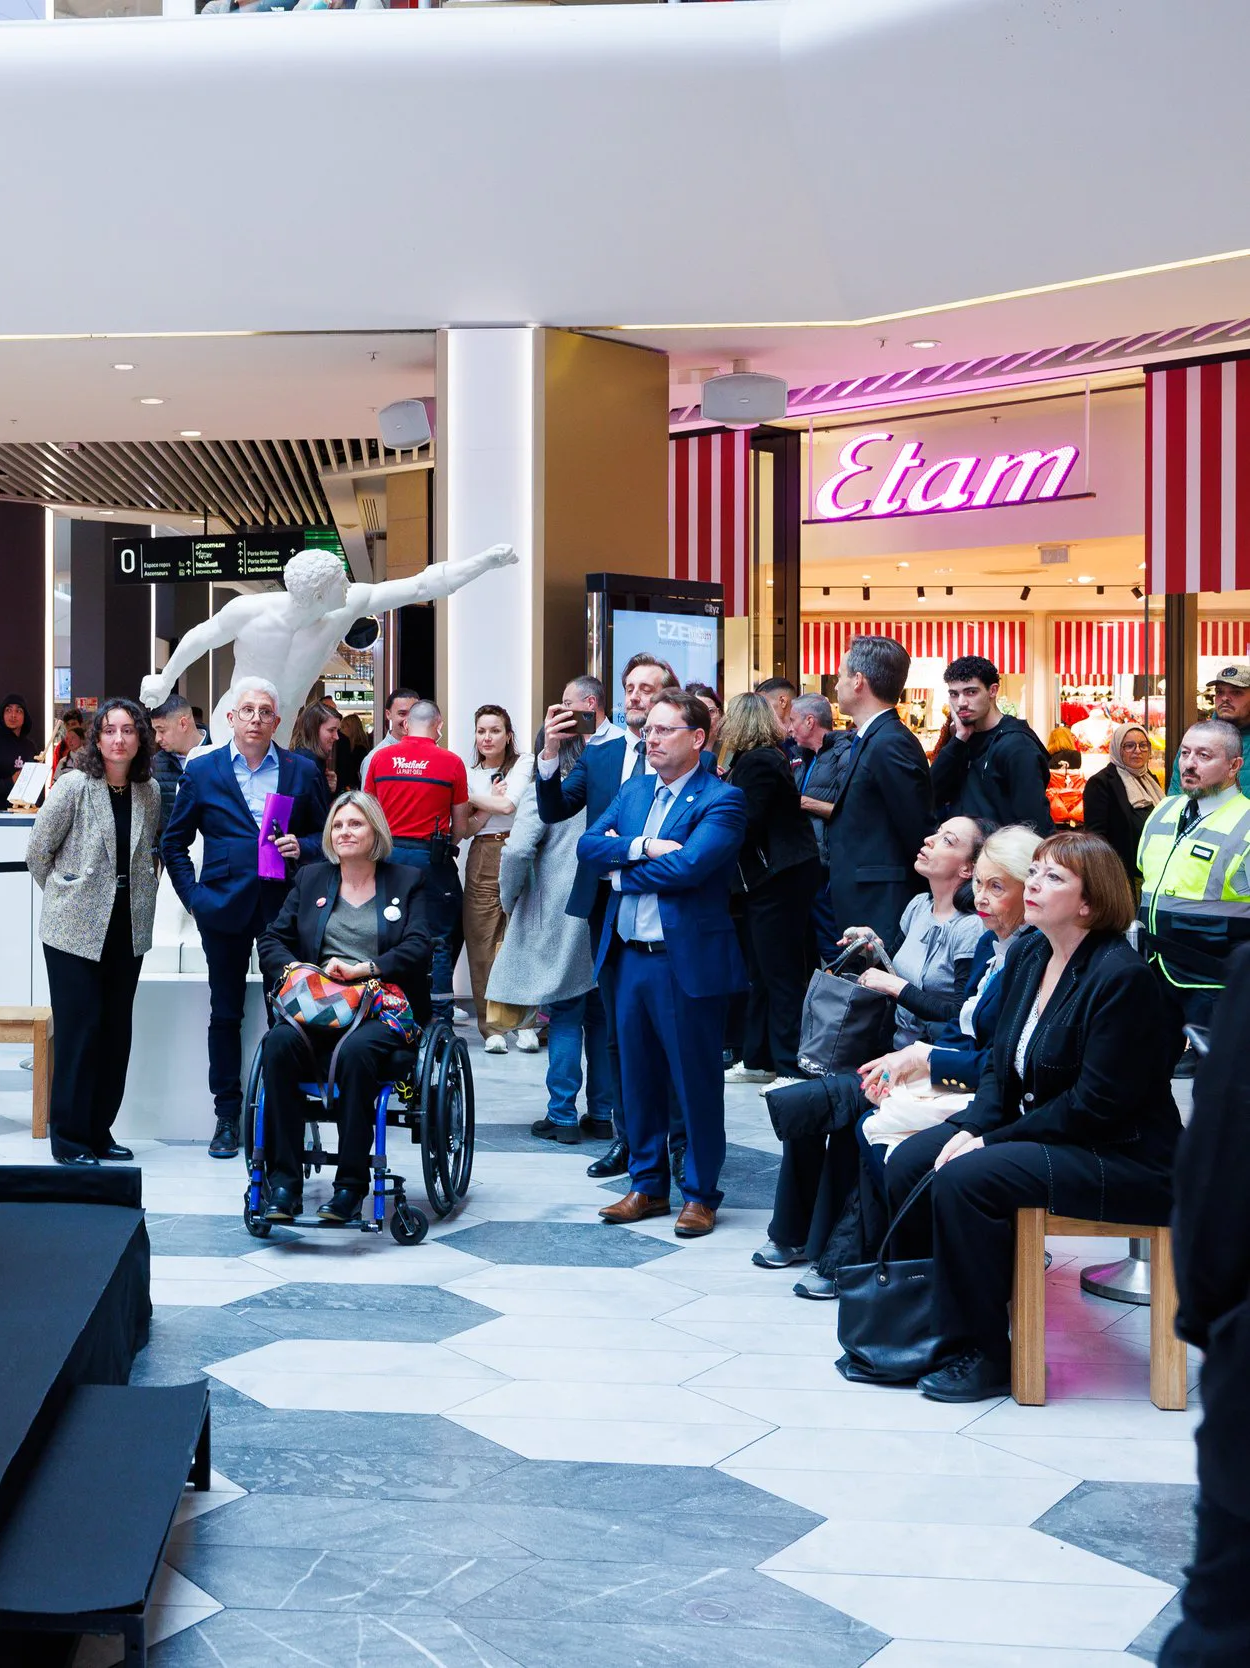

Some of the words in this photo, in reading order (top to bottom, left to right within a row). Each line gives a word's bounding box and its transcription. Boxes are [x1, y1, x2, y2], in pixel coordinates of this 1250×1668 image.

[815, 432, 1079, 519] Etam
[121, 549, 135, 573] 0
[391, 756, 430, 770] Westfield
